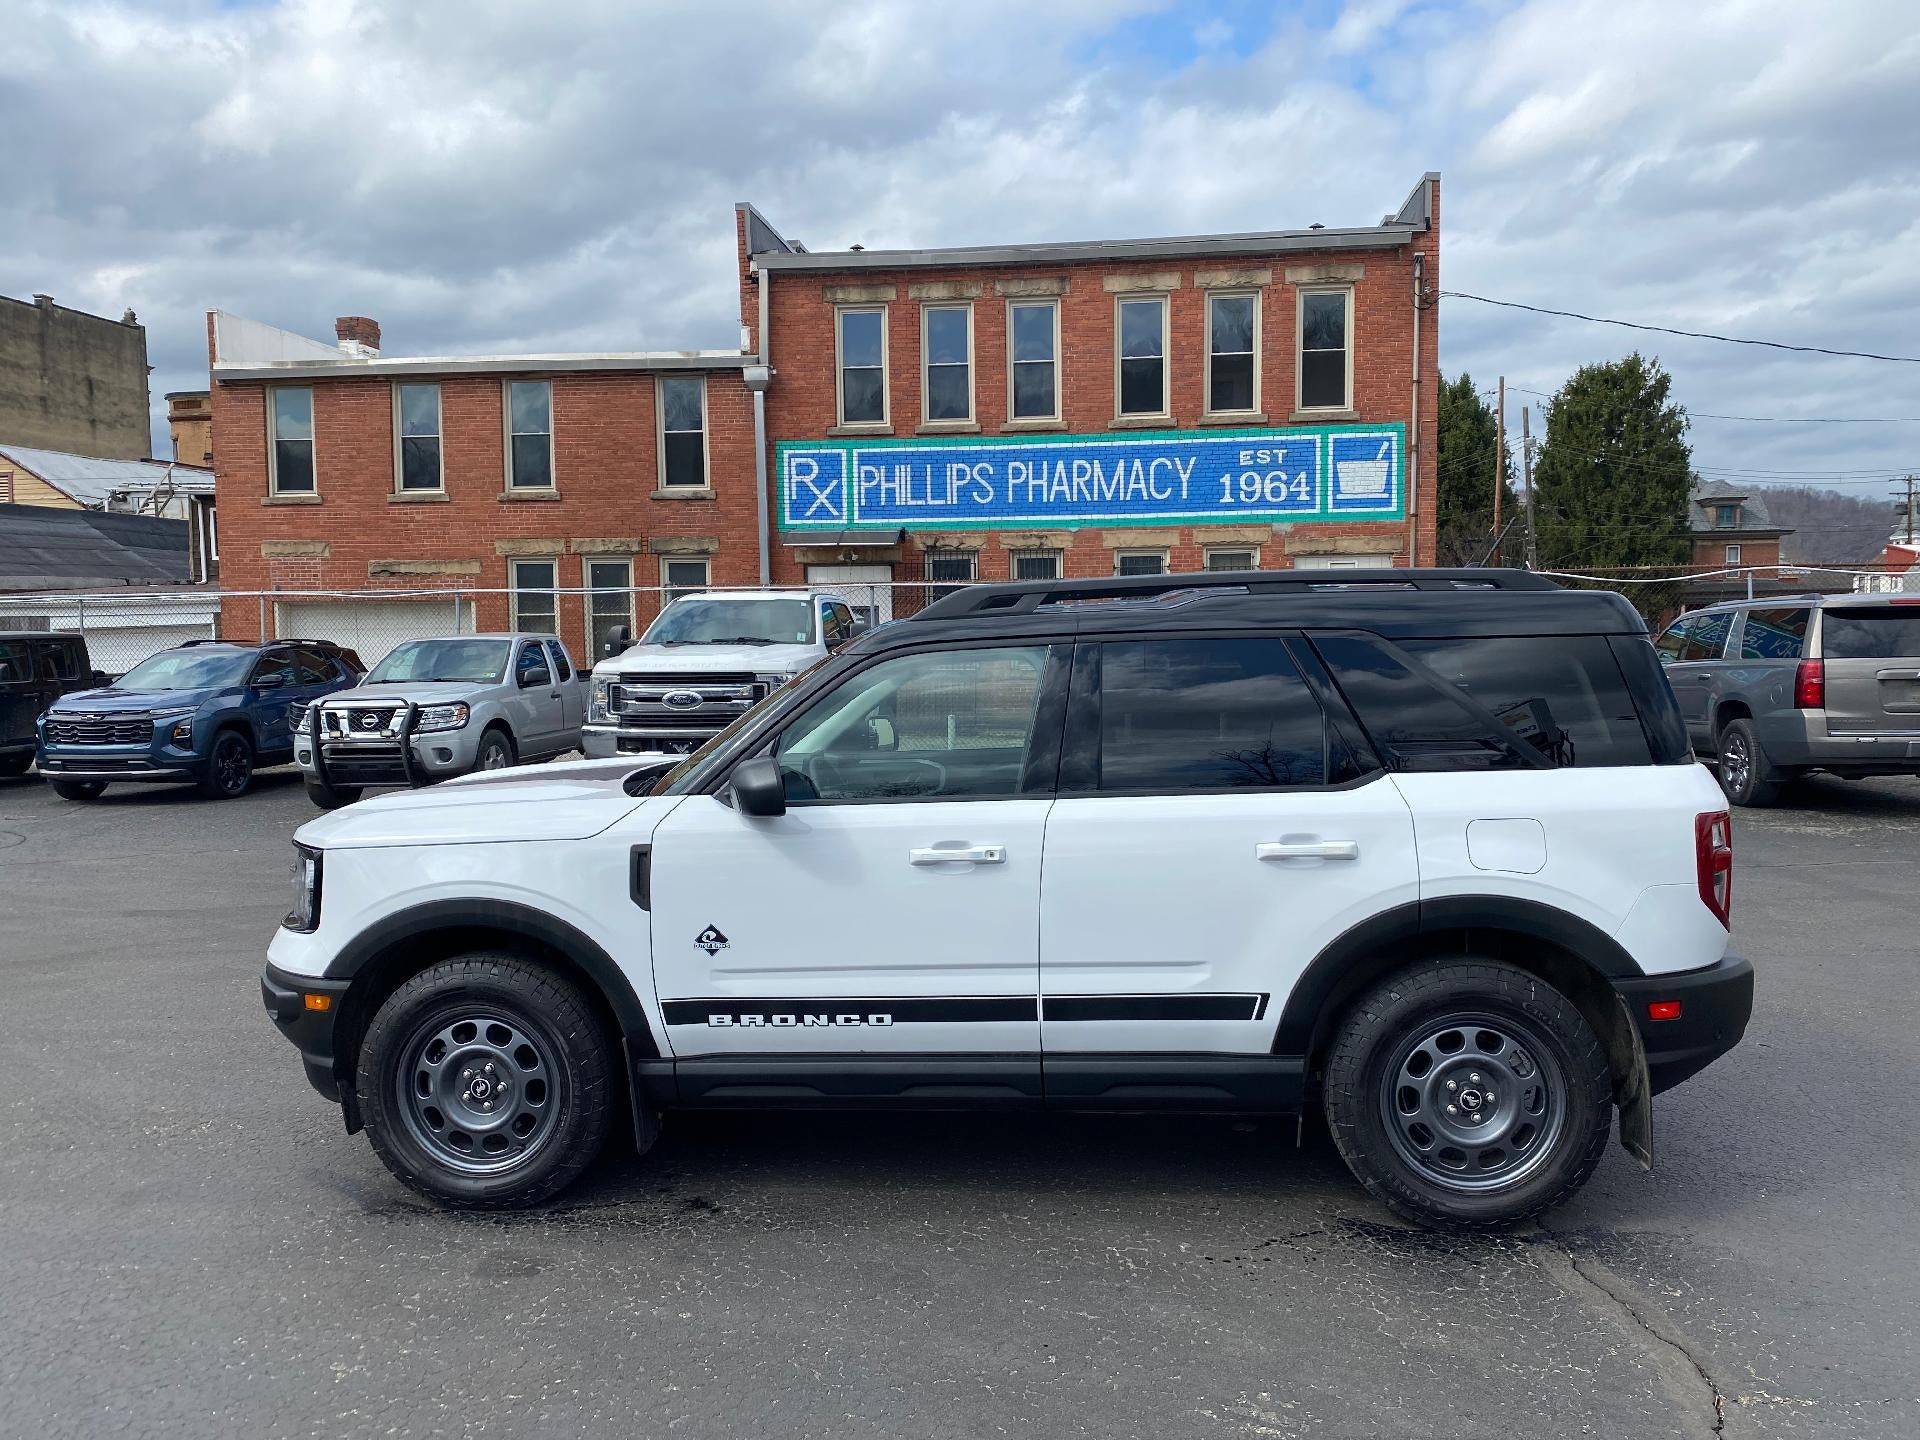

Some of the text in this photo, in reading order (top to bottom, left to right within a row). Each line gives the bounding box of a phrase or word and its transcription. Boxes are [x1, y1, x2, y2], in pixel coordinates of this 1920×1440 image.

[1239, 449, 1288, 466] EST
[860, 456, 1197, 506] PHILLIPS PHARMACY
[1219, 470, 1311, 503] 1964
[708, 1013, 893, 1028] BRONCO
